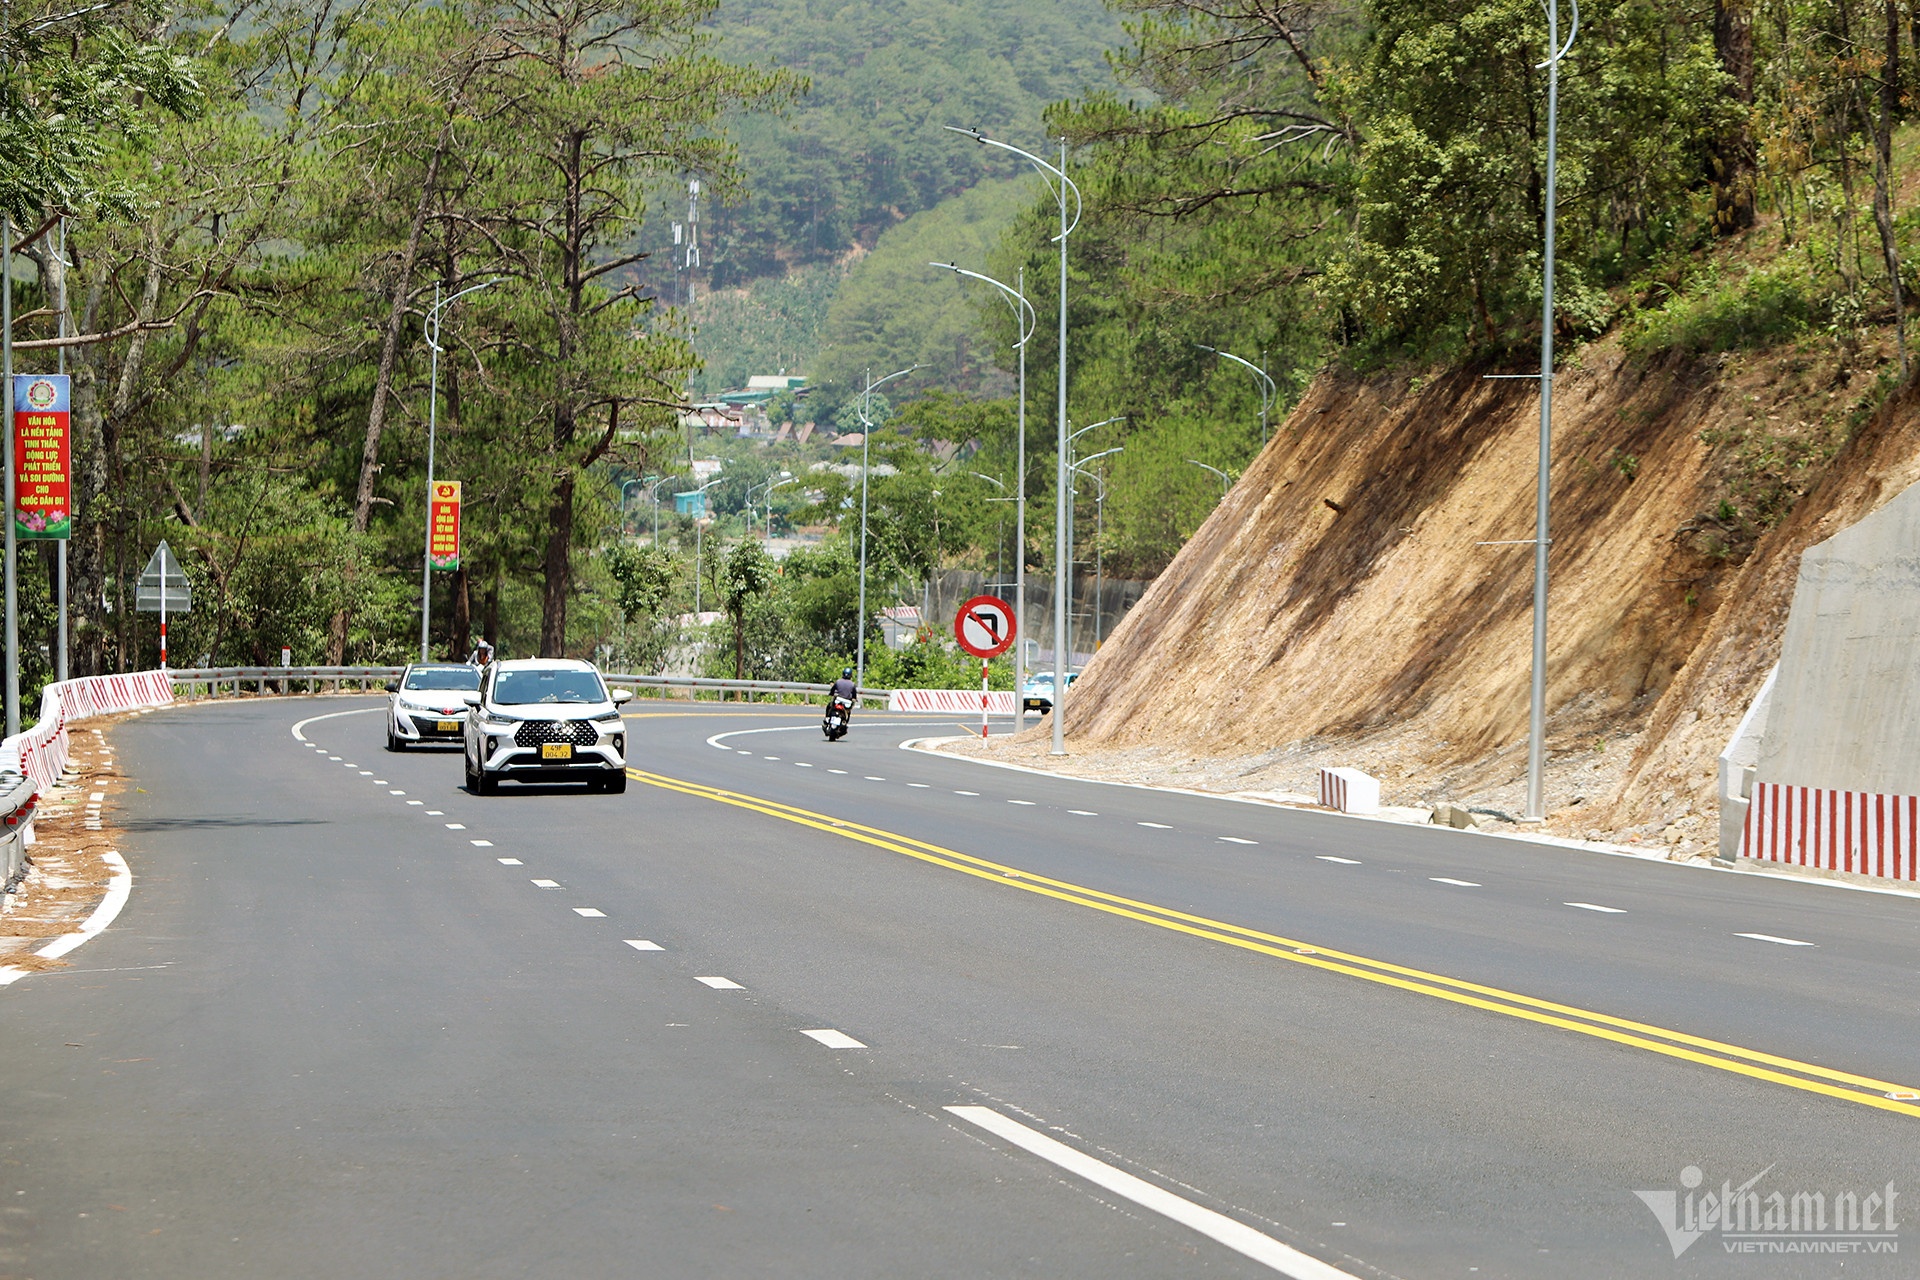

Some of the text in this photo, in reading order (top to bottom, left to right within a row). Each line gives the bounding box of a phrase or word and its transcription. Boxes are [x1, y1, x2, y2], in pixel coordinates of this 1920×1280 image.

[21, 427, 29, 437] LÀ
[24, 440, 39, 448] TINH
[24, 462, 40, 471] PHÁT
[20, 472, 28, 482] VÀ
[30, 474, 41, 482] SOI
[36, 485, 49, 494] CHO
[21, 494, 38, 506] QUỐC
